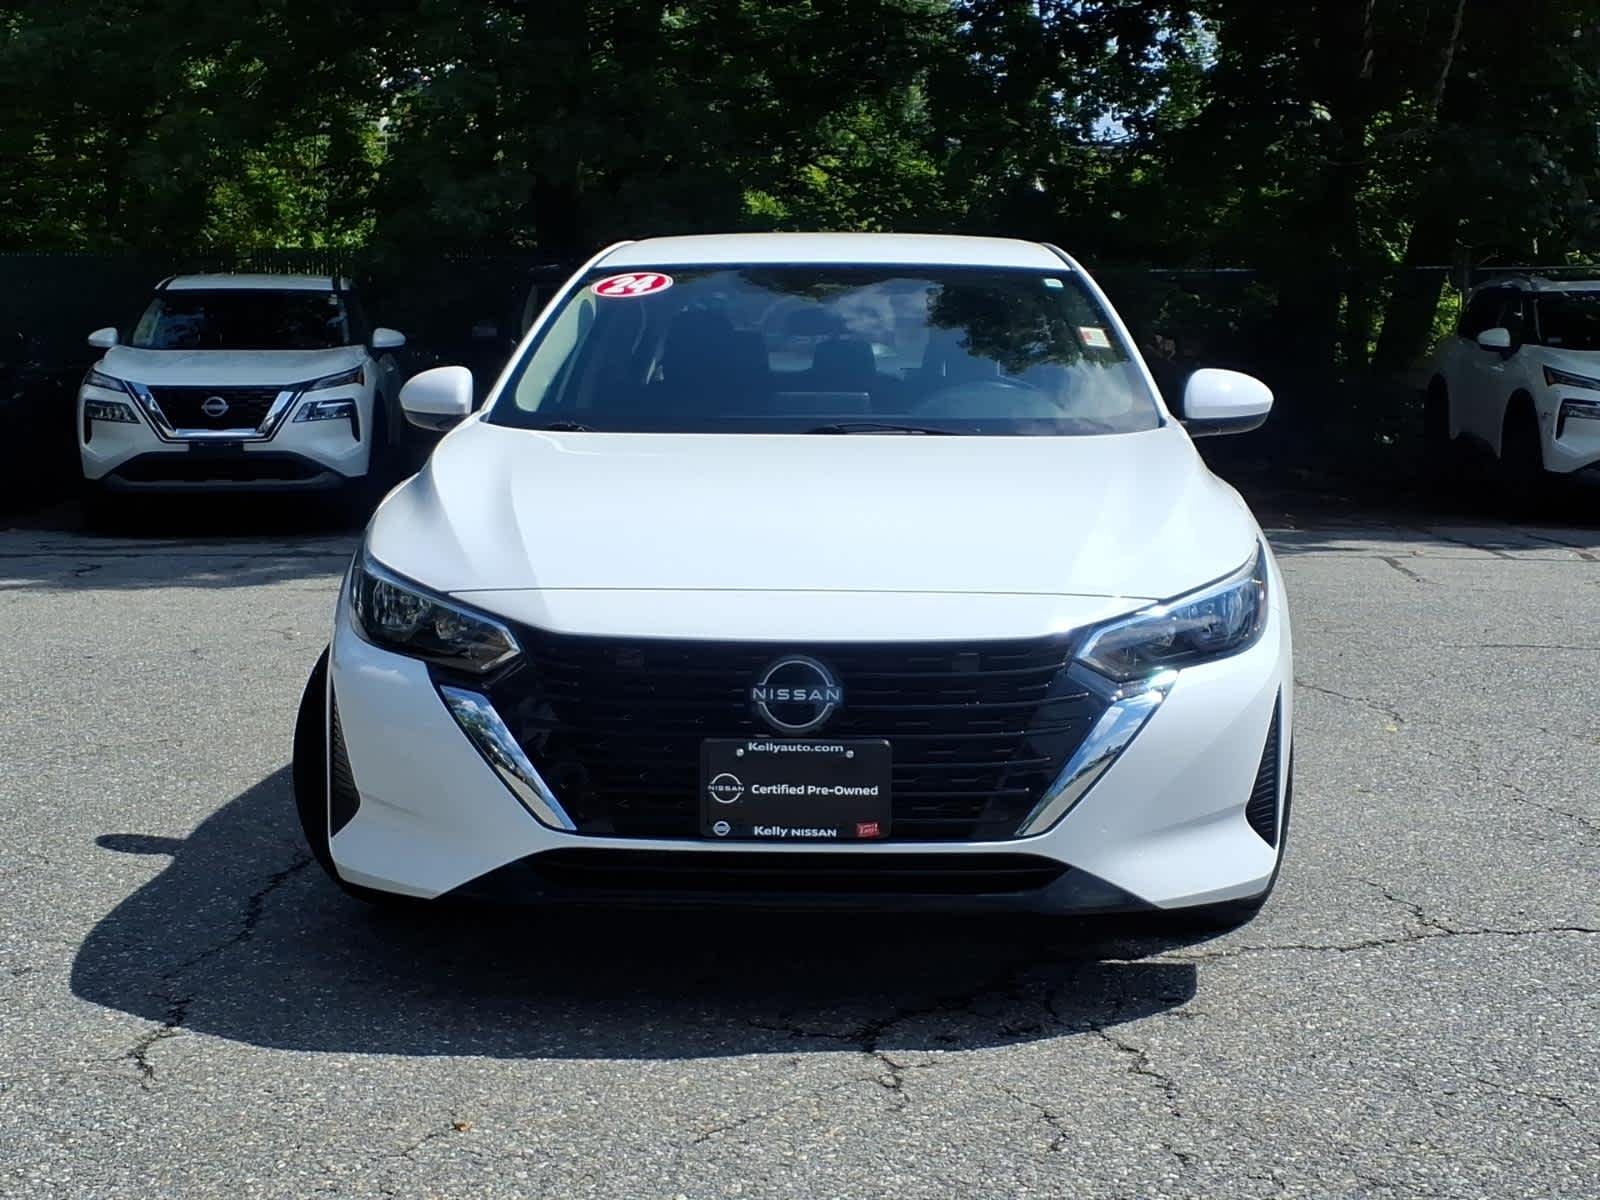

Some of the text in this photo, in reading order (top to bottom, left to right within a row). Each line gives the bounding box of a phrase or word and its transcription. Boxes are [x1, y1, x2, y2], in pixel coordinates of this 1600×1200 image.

[602, 275, 658, 294] 24
[752, 687, 840, 701] NISSAN
[748, 742, 844, 754] Kellyauto.com
[751, 784, 879, 796] Certified Pre-Owned
[753, 825, 837, 838] Kelly NISSAN
